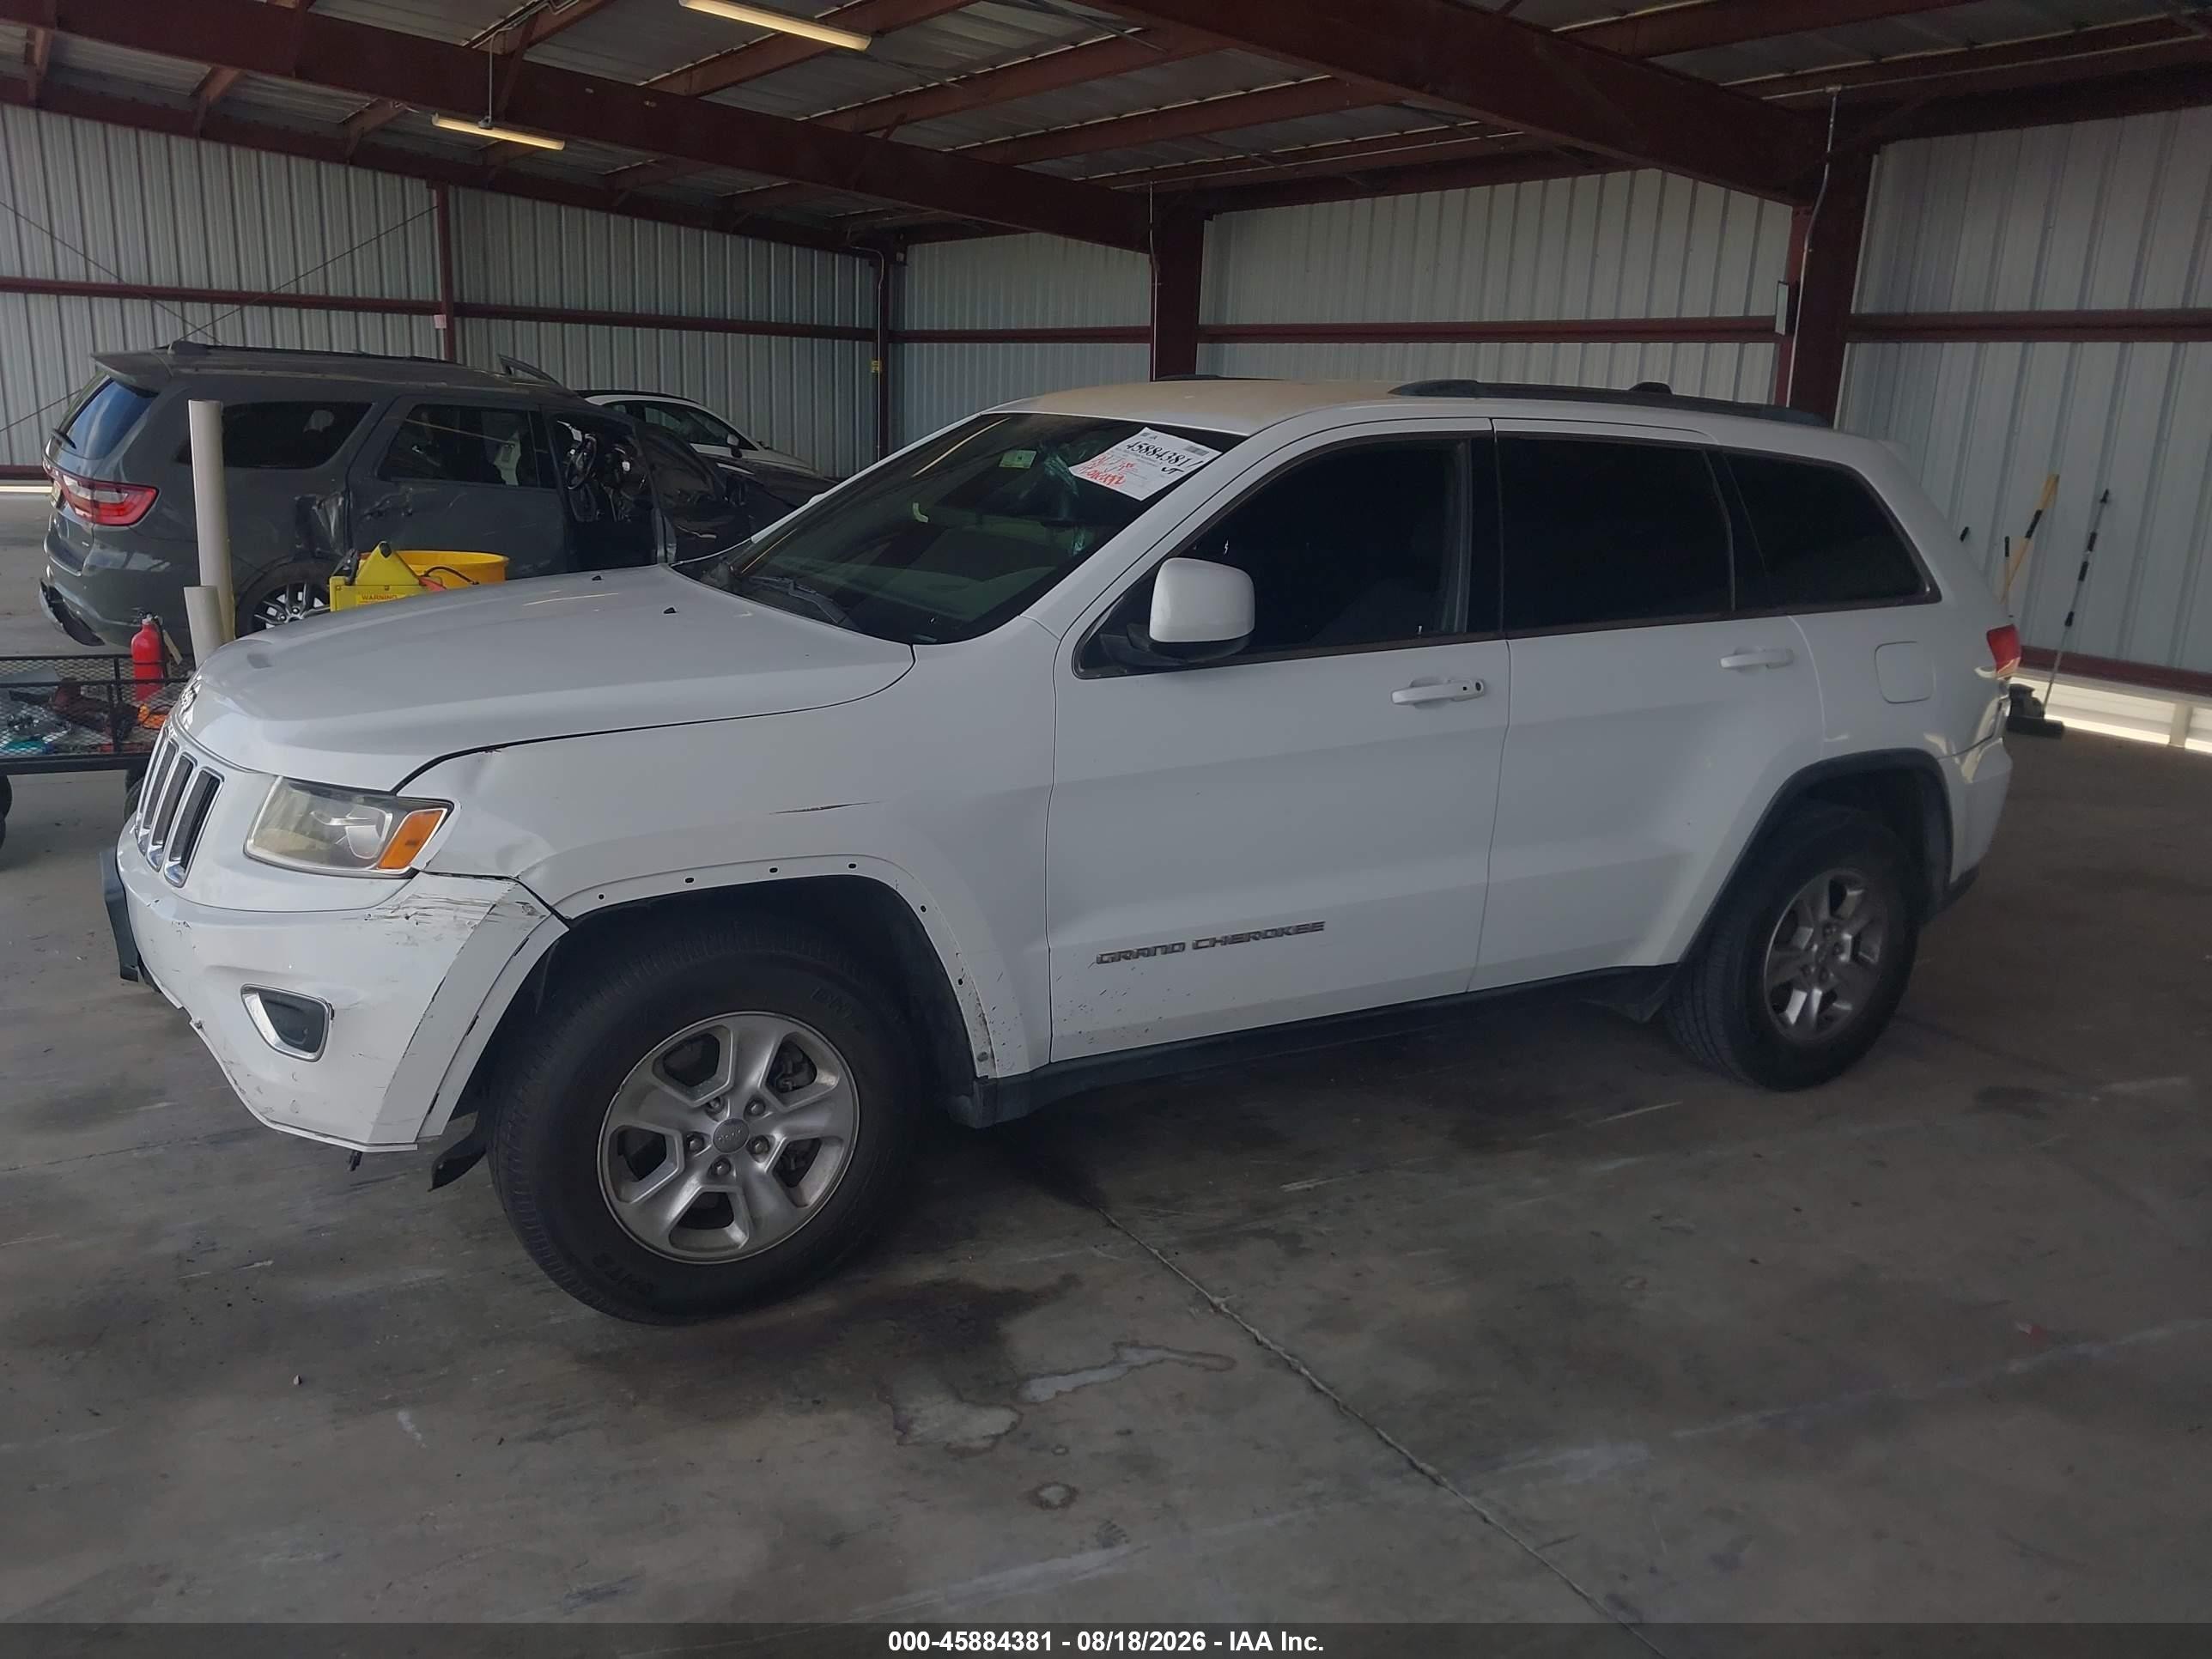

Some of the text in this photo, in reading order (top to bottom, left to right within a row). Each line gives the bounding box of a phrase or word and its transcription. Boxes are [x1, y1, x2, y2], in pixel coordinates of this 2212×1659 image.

[1126, 441, 1190, 468] 45884381
[1096, 921, 1326, 964] GRAND CHEROKEE
